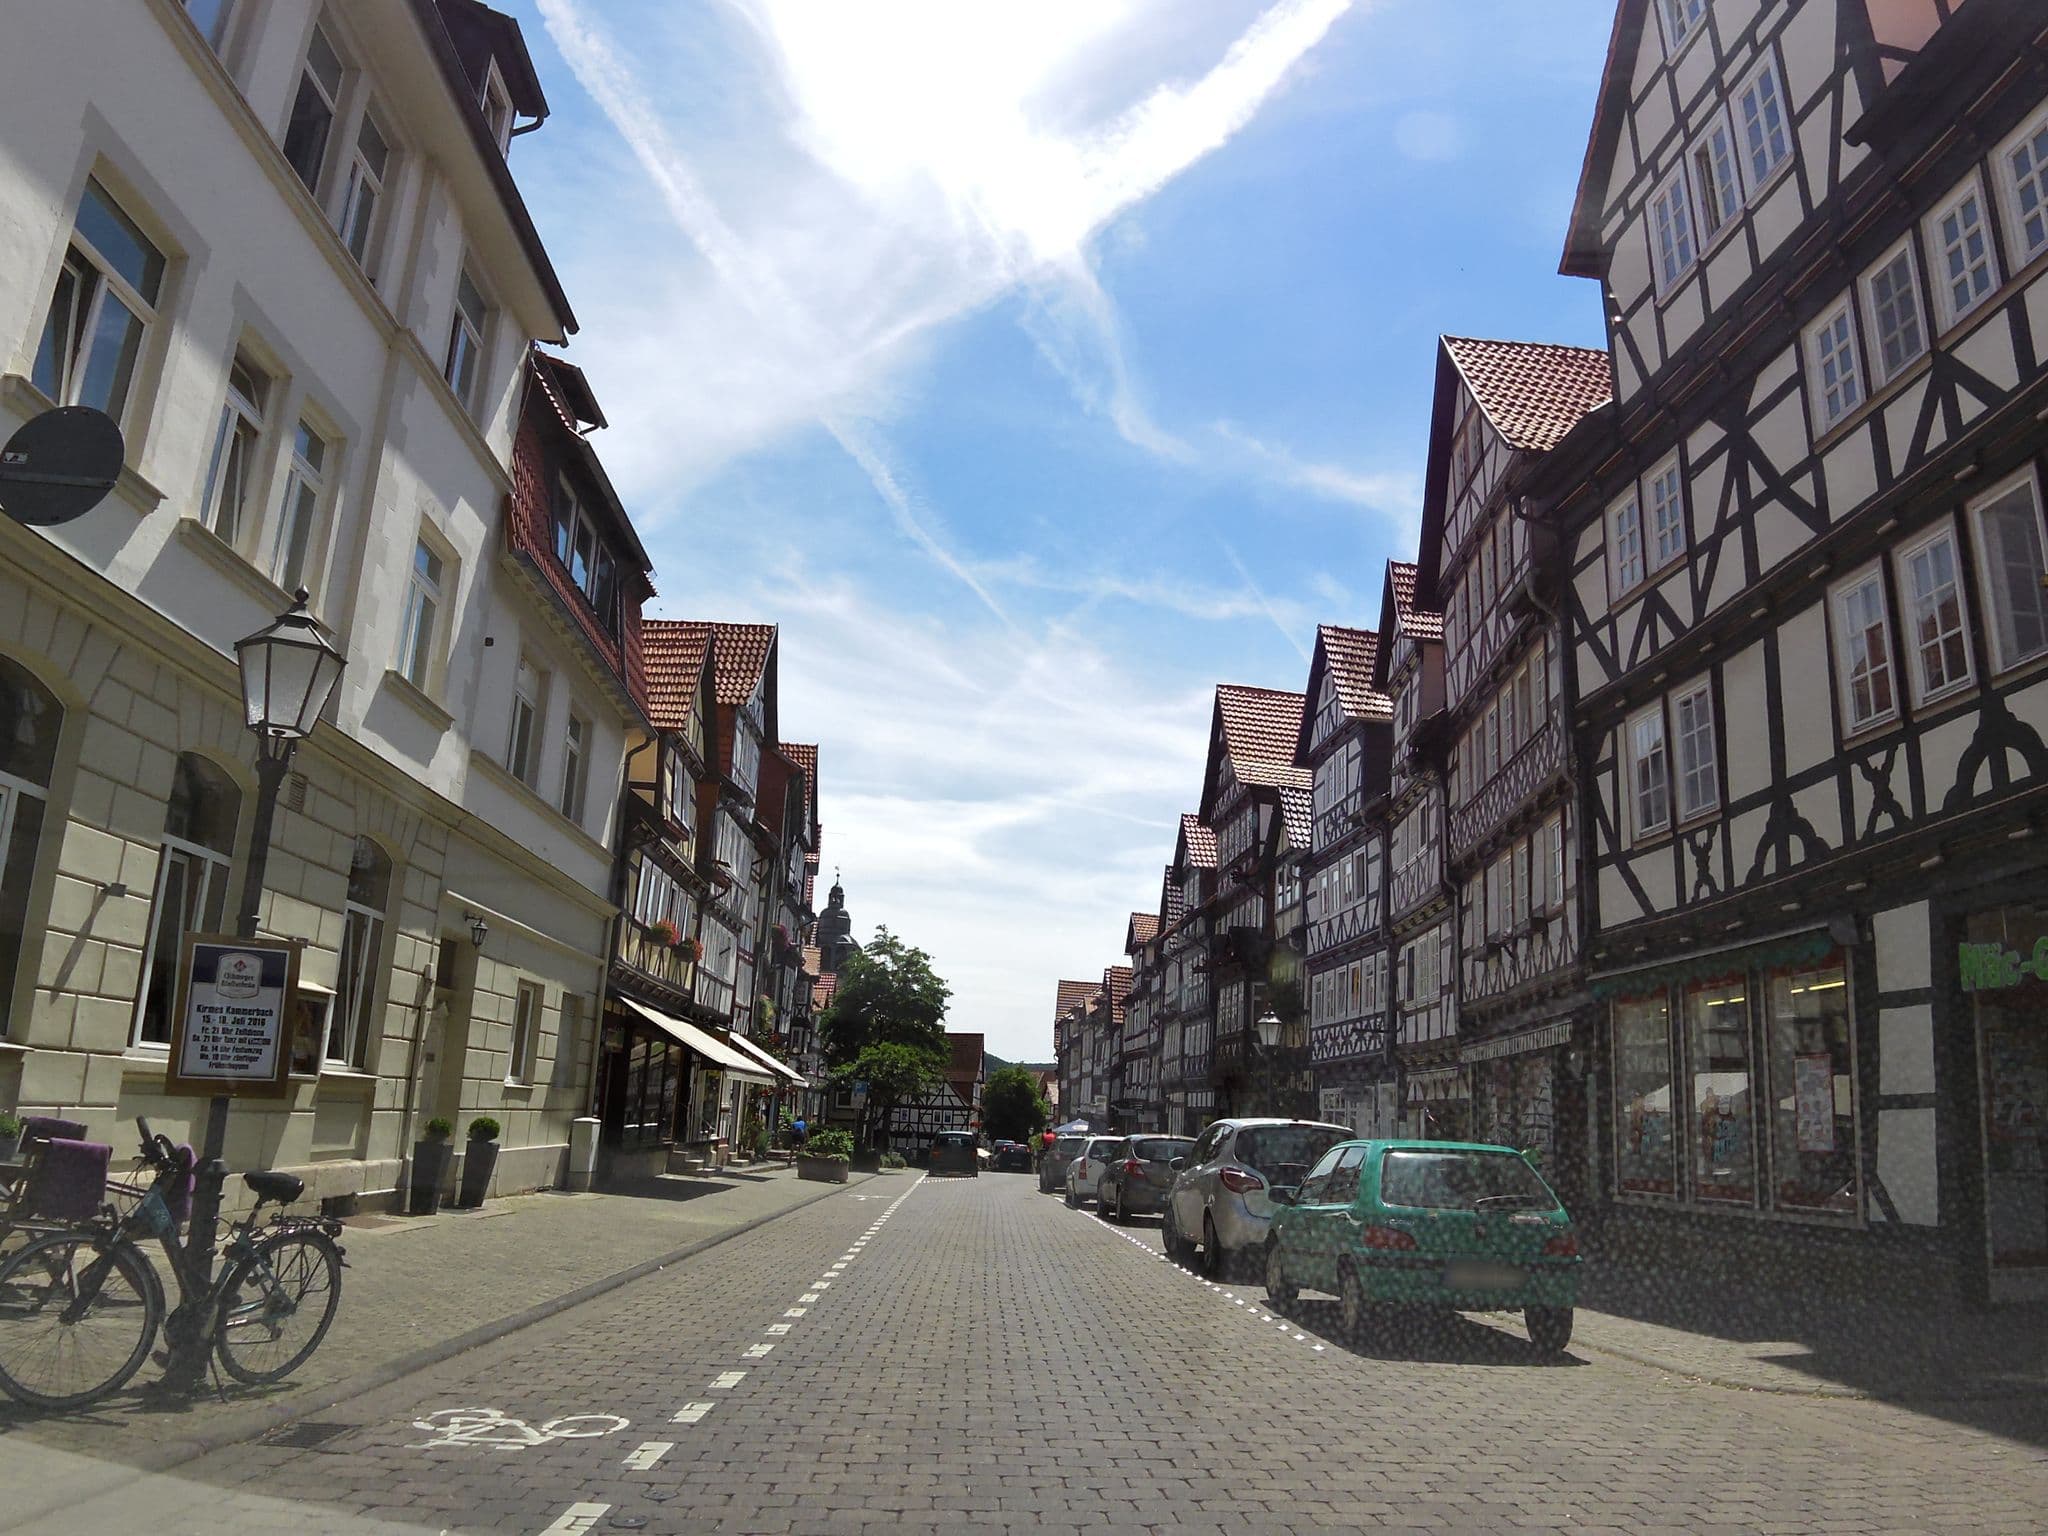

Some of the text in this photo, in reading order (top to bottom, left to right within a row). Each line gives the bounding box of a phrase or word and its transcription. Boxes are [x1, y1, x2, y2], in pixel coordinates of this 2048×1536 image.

[196, 1004, 273, 1017] Kirmes Kammerbach
[231, 1016, 245, 1025] Juli
[211, 1026, 219, 1034] 21
[222, 1027, 233, 1035] Uhr
